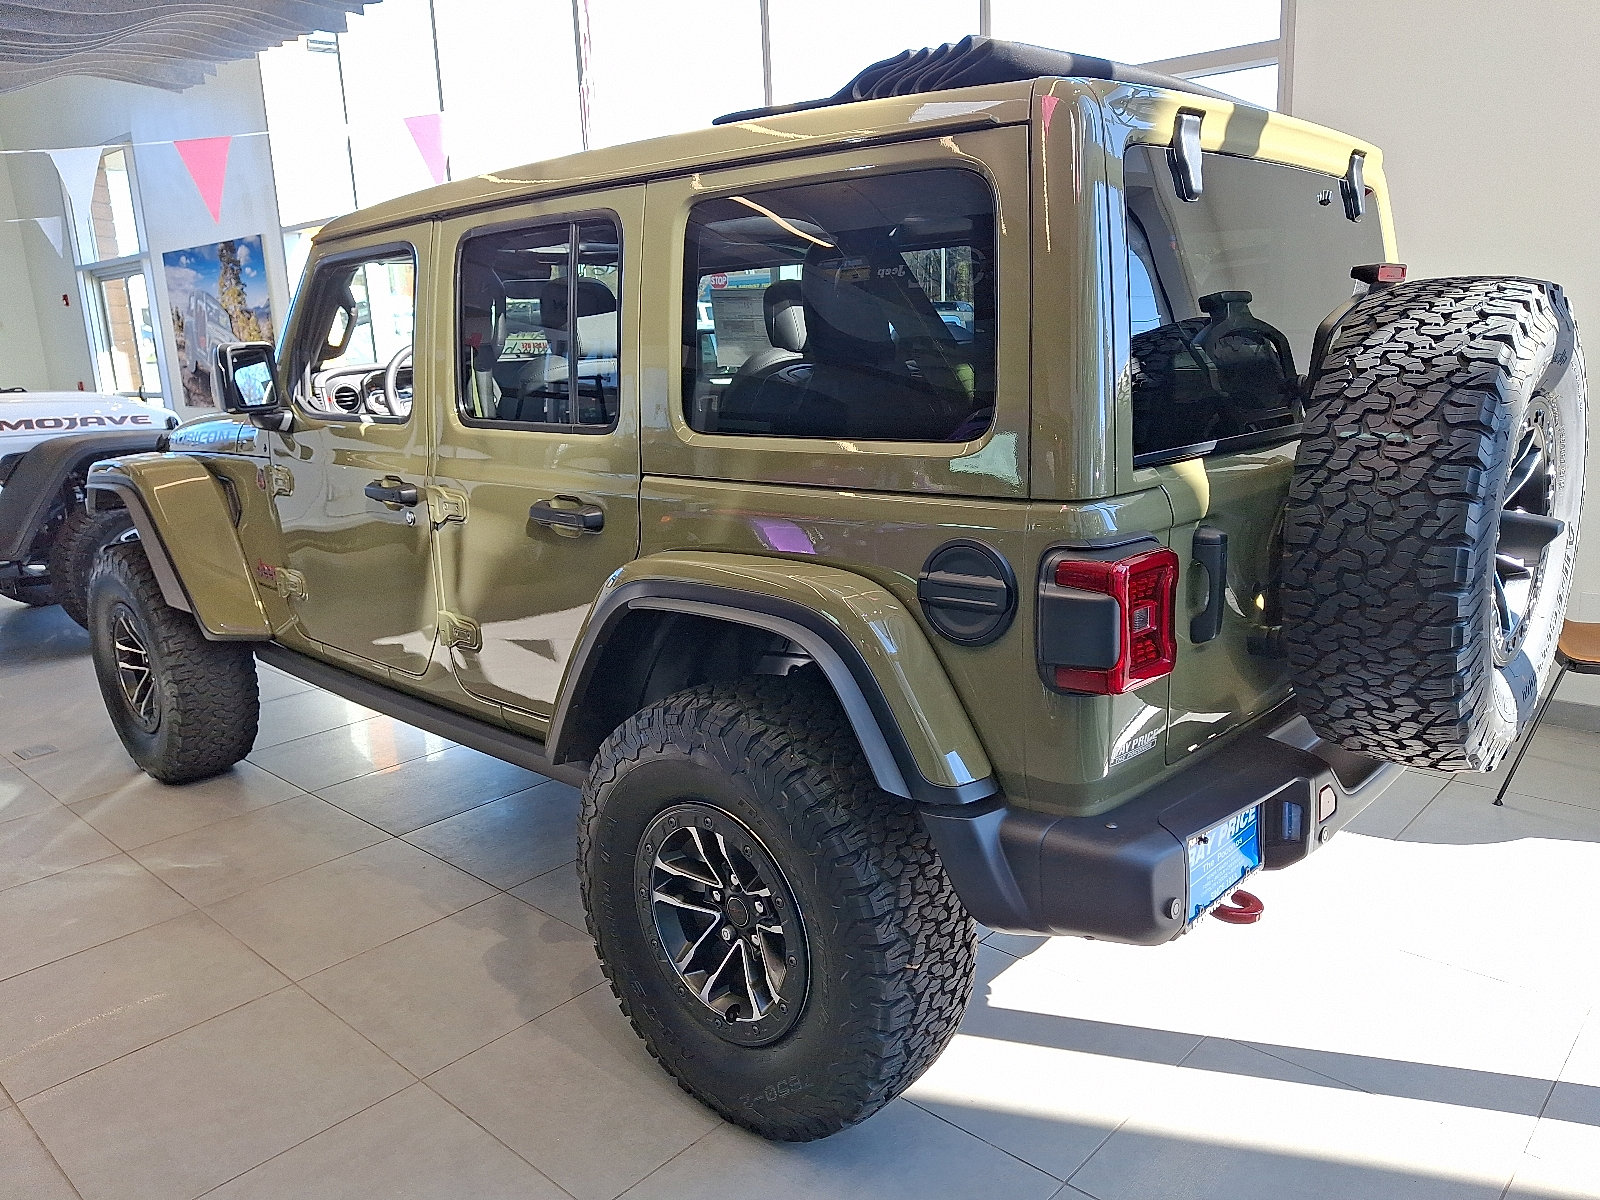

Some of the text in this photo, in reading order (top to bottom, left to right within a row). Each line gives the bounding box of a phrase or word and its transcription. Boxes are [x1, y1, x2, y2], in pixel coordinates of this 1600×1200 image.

[711, 276, 727, 286] STOP
[0, 415, 152, 431] MOJAVE
[1131, 728, 1158, 749] PRICE
[1217, 807, 1256, 845] PRICE
[1203, 860, 1215, 873] The
